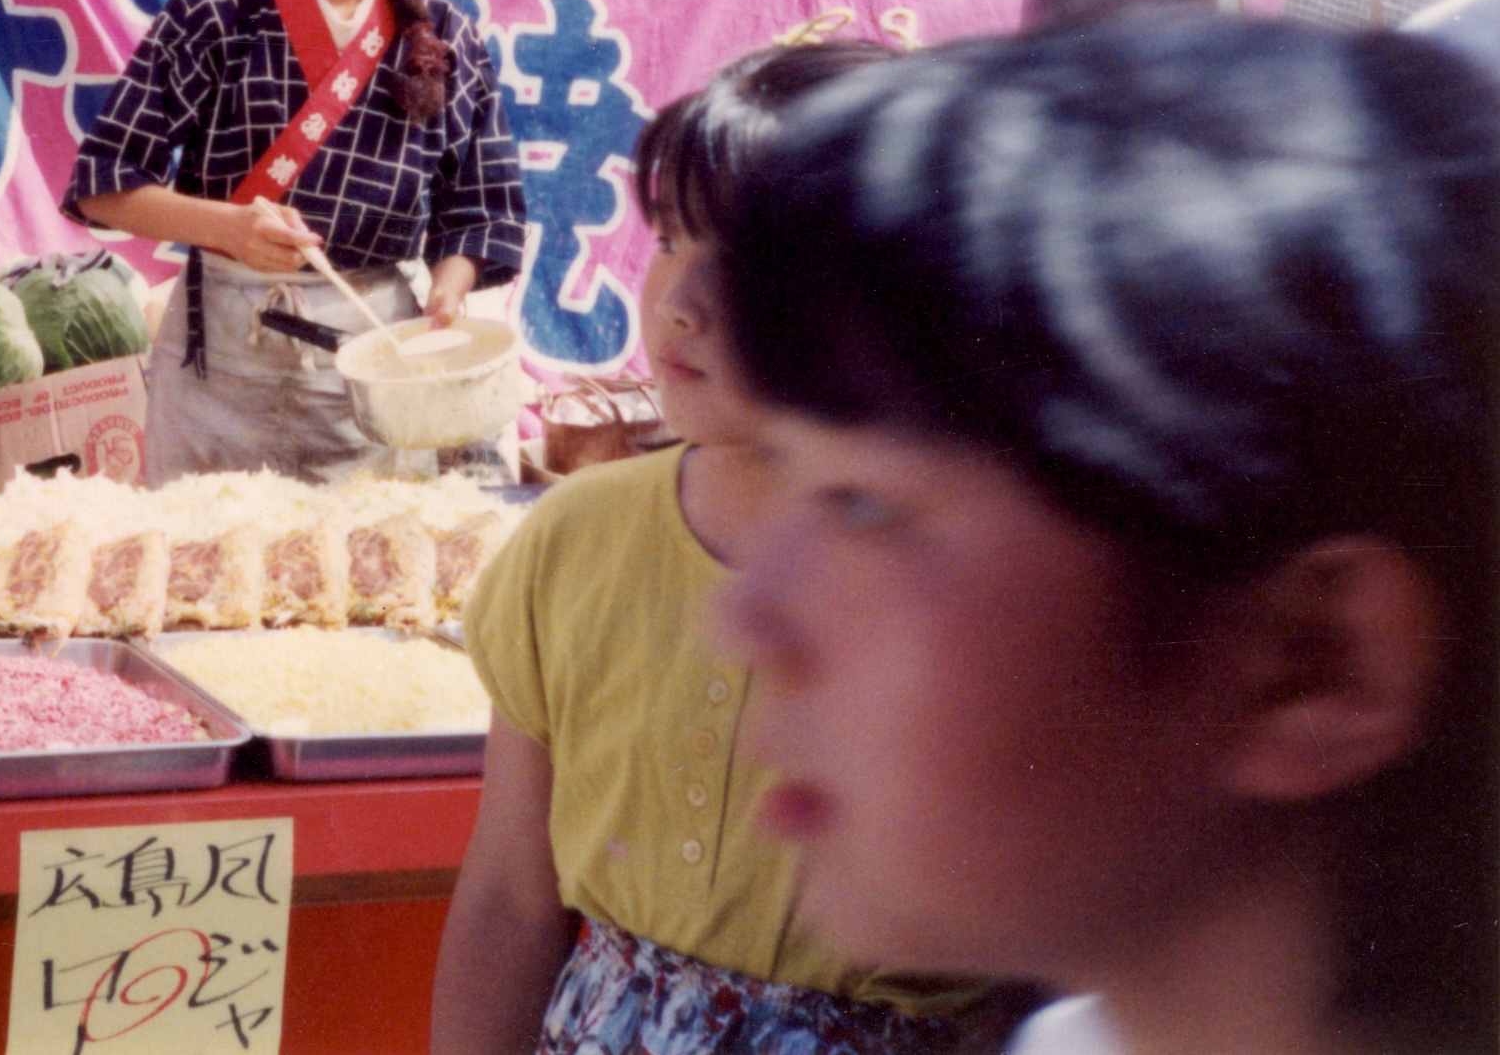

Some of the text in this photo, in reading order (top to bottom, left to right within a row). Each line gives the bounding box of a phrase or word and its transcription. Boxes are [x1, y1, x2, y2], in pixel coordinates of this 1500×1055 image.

[61, 374, 127, 397] PRODUCT
[33, 392, 50, 405] OF
[53, 387, 129, 412] PRODUCTO
[25, 402, 51, 419] DEL
